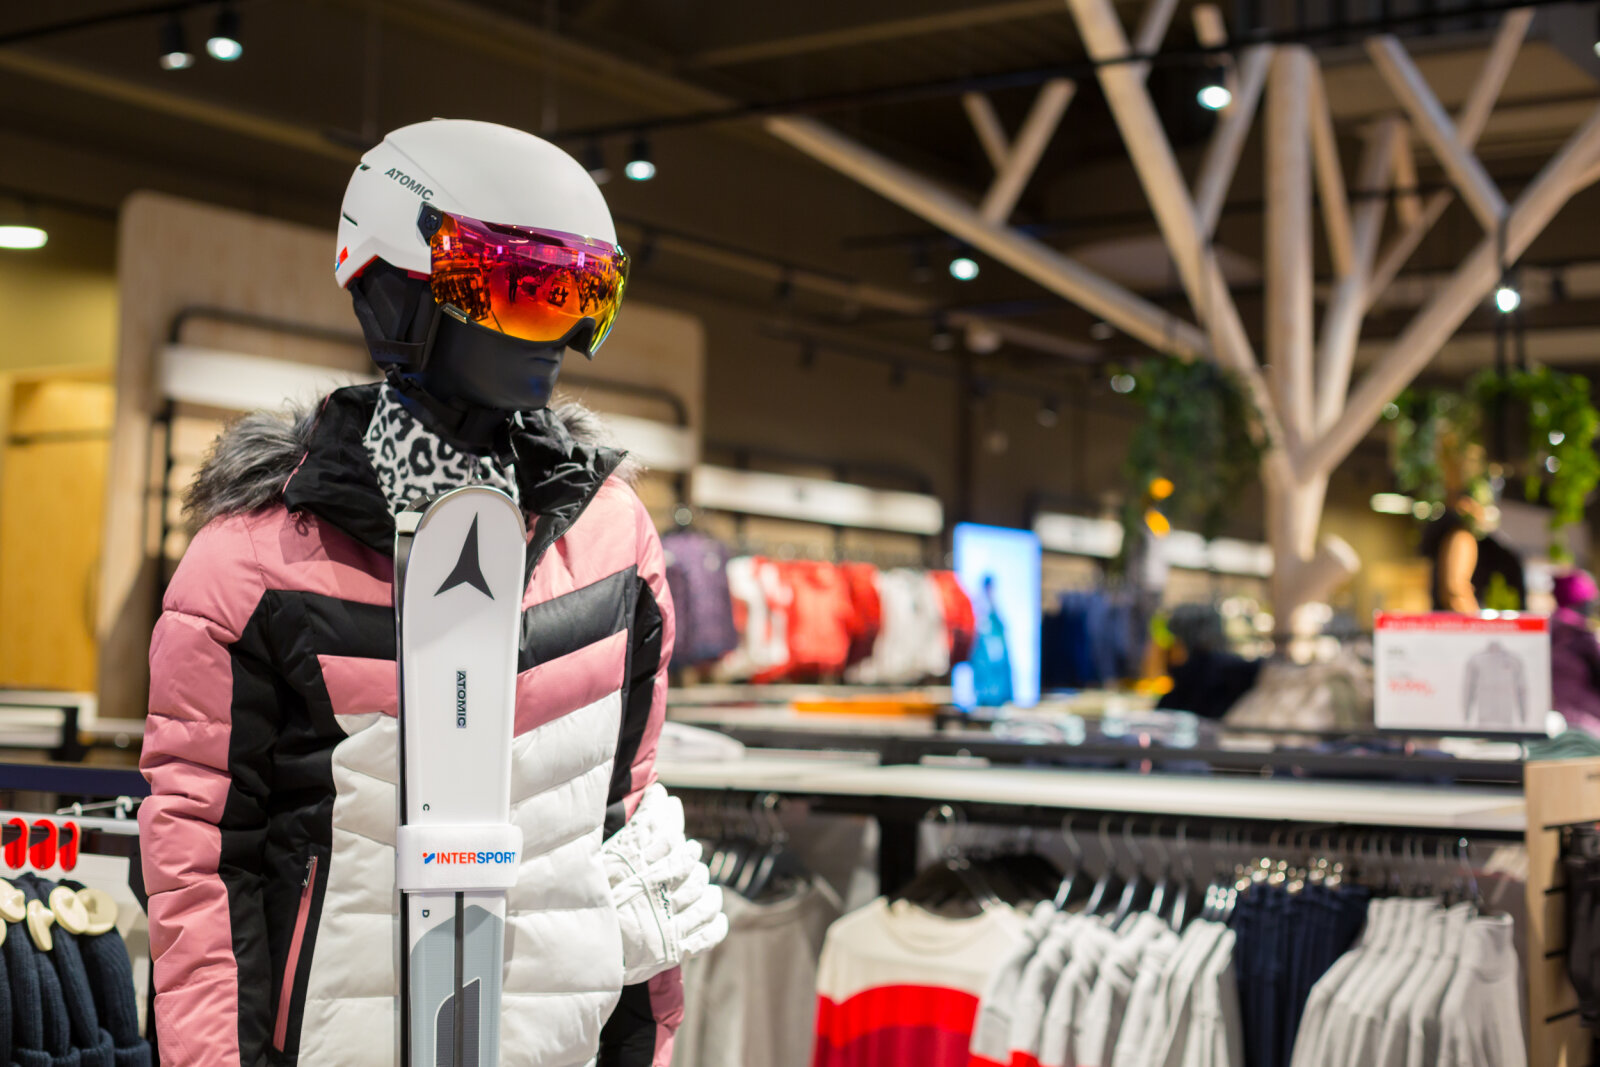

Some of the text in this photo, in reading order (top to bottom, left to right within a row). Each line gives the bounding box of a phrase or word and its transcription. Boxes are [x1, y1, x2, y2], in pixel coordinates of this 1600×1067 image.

[384, 168, 434, 200] ATOMIC
[457, 671, 466, 727] ATOMIC
[422, 803, 430, 811] C
[437, 851, 516, 864] INTERSPORT
[422, 909, 430, 918] D
